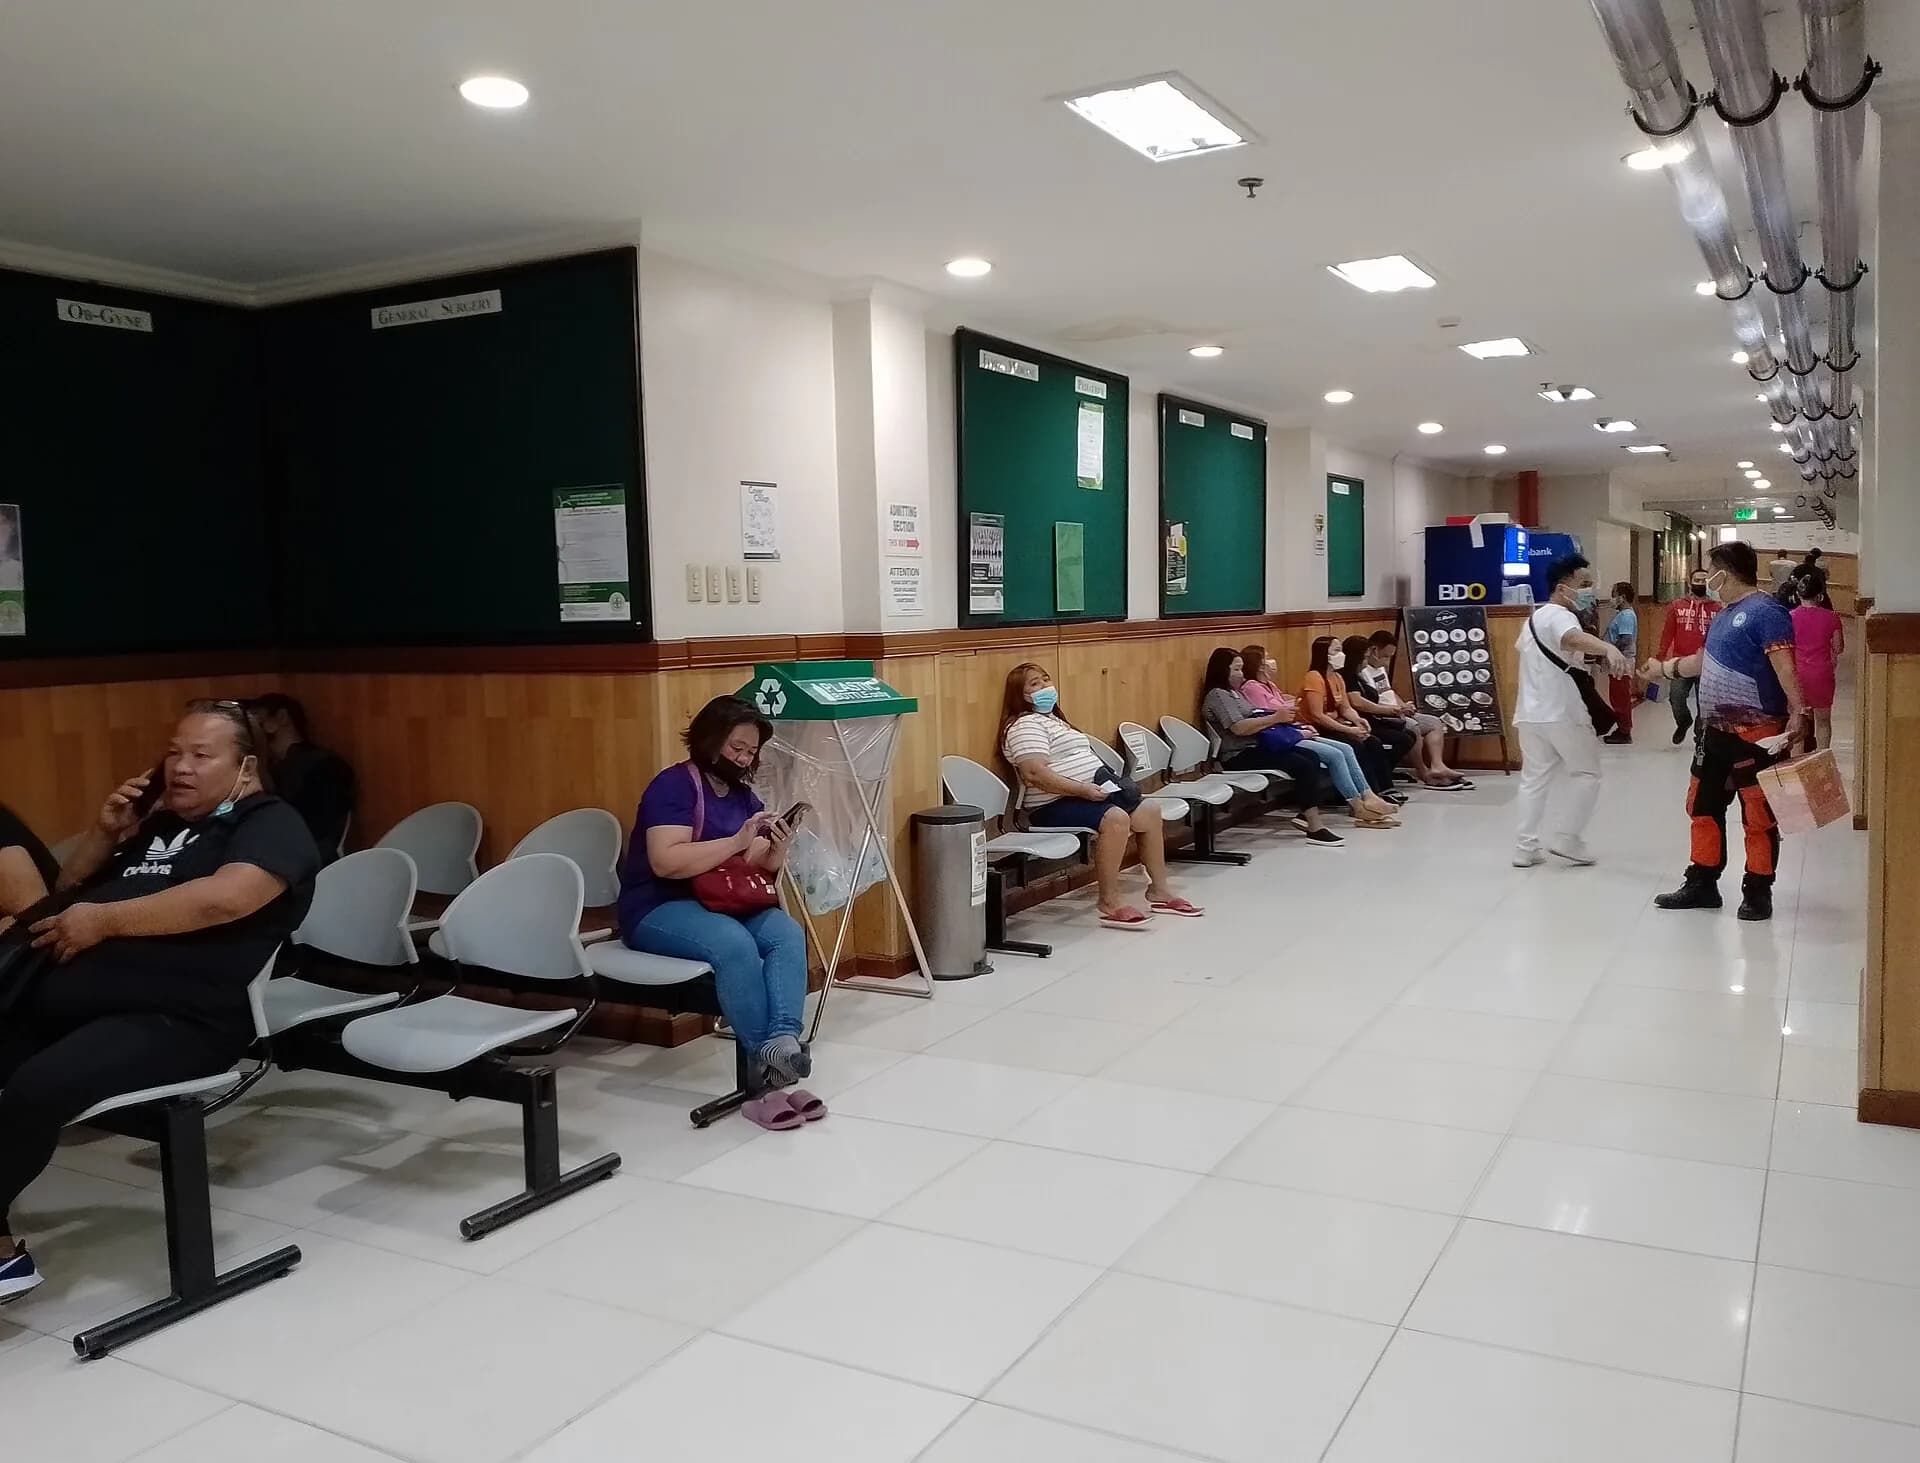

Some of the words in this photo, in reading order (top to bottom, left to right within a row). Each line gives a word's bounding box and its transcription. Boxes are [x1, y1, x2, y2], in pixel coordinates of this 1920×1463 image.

[893, 519, 914, 532] SECTION
[890, 567, 919, 576] ATTENTION
[1438, 583, 1487, 600] BDO
[819, 678, 880, 693] PLASTIC
[832, 690, 872, 700] BOTTLE
[122, 861, 172, 877] adidas
